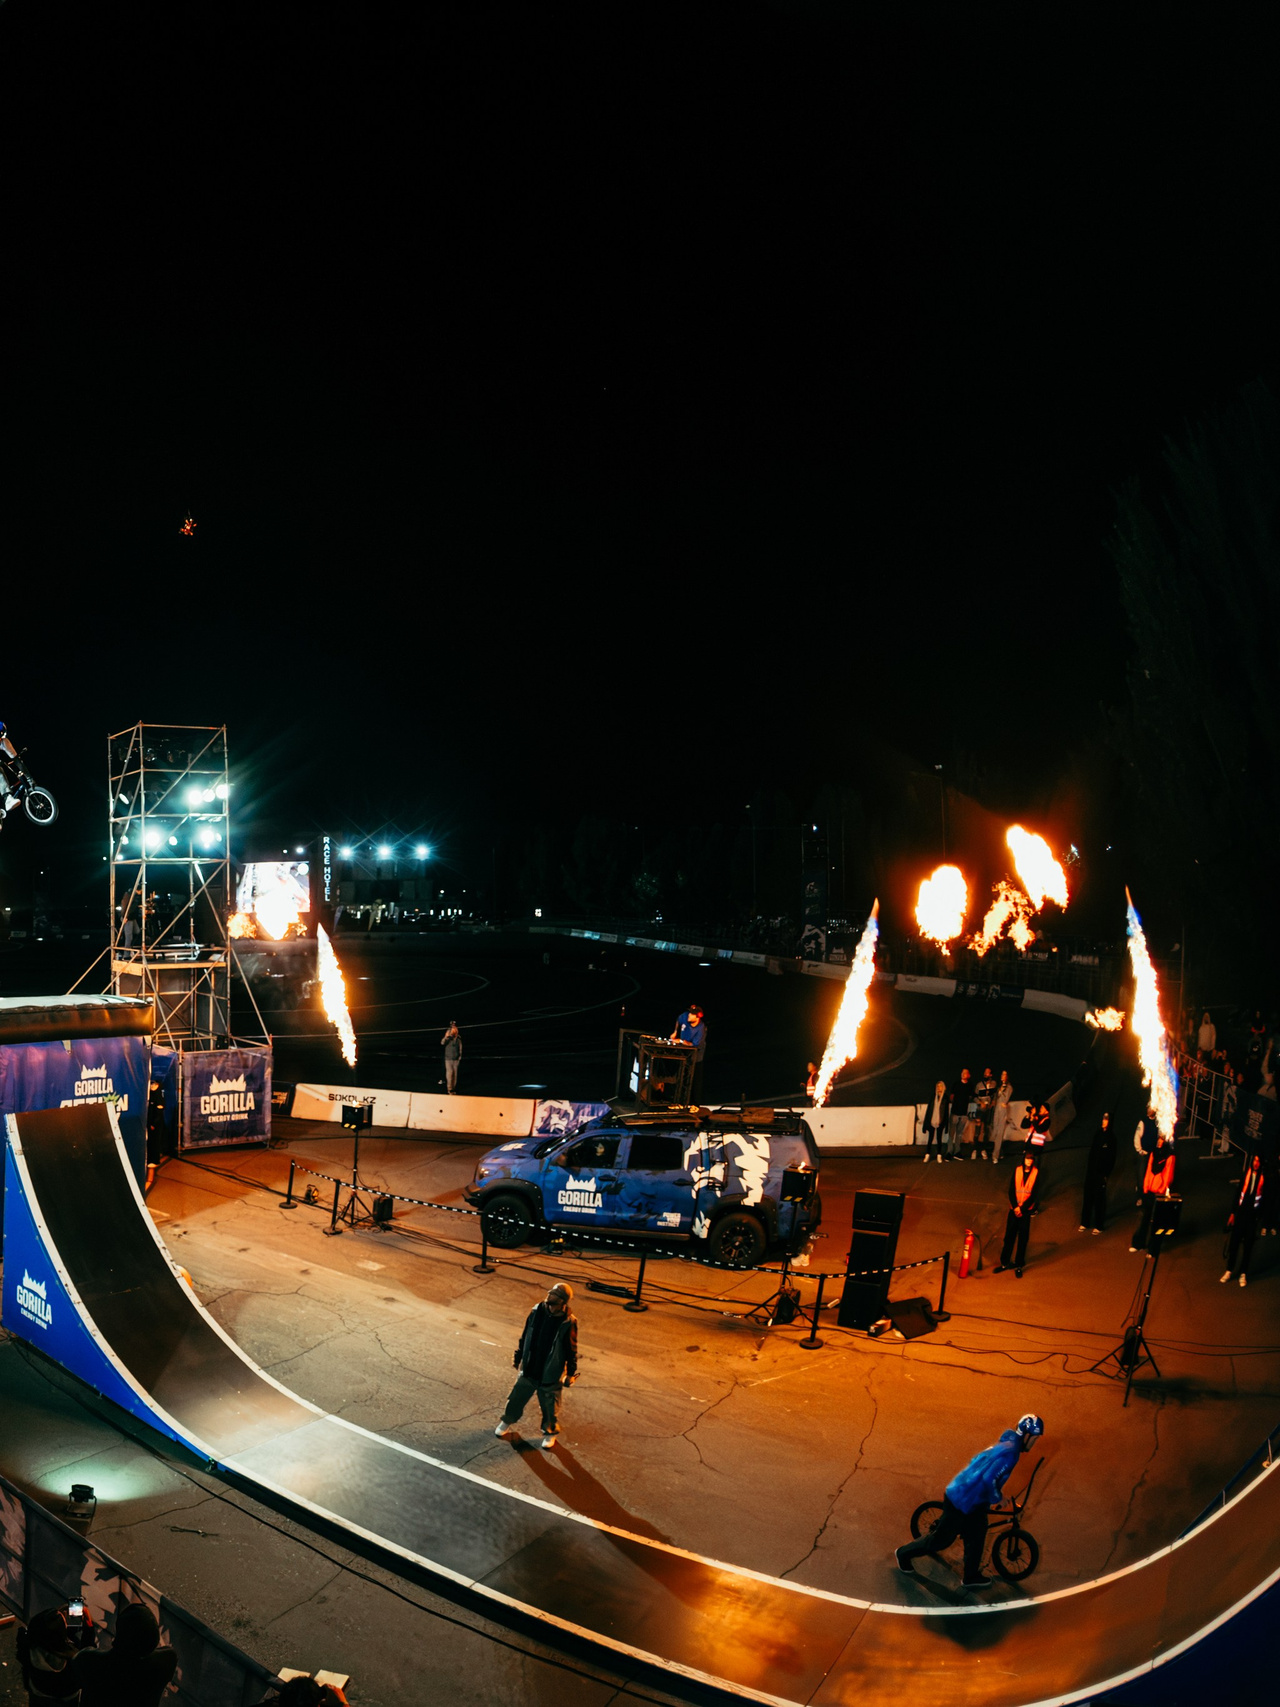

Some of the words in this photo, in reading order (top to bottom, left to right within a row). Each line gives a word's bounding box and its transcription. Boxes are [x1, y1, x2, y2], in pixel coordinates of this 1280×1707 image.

[323, 836, 331, 865] RACE
[324, 867, 332, 902] HOTEL
[74, 1078, 113, 1096] GORILLA
[201, 1092, 255, 1114] GORILLA
[328, 1093, 376, 1104] SOKOLKZ
[558, 1190, 602, 1207] GORILLA
[17, 1285, 52, 1324] GORILLA
